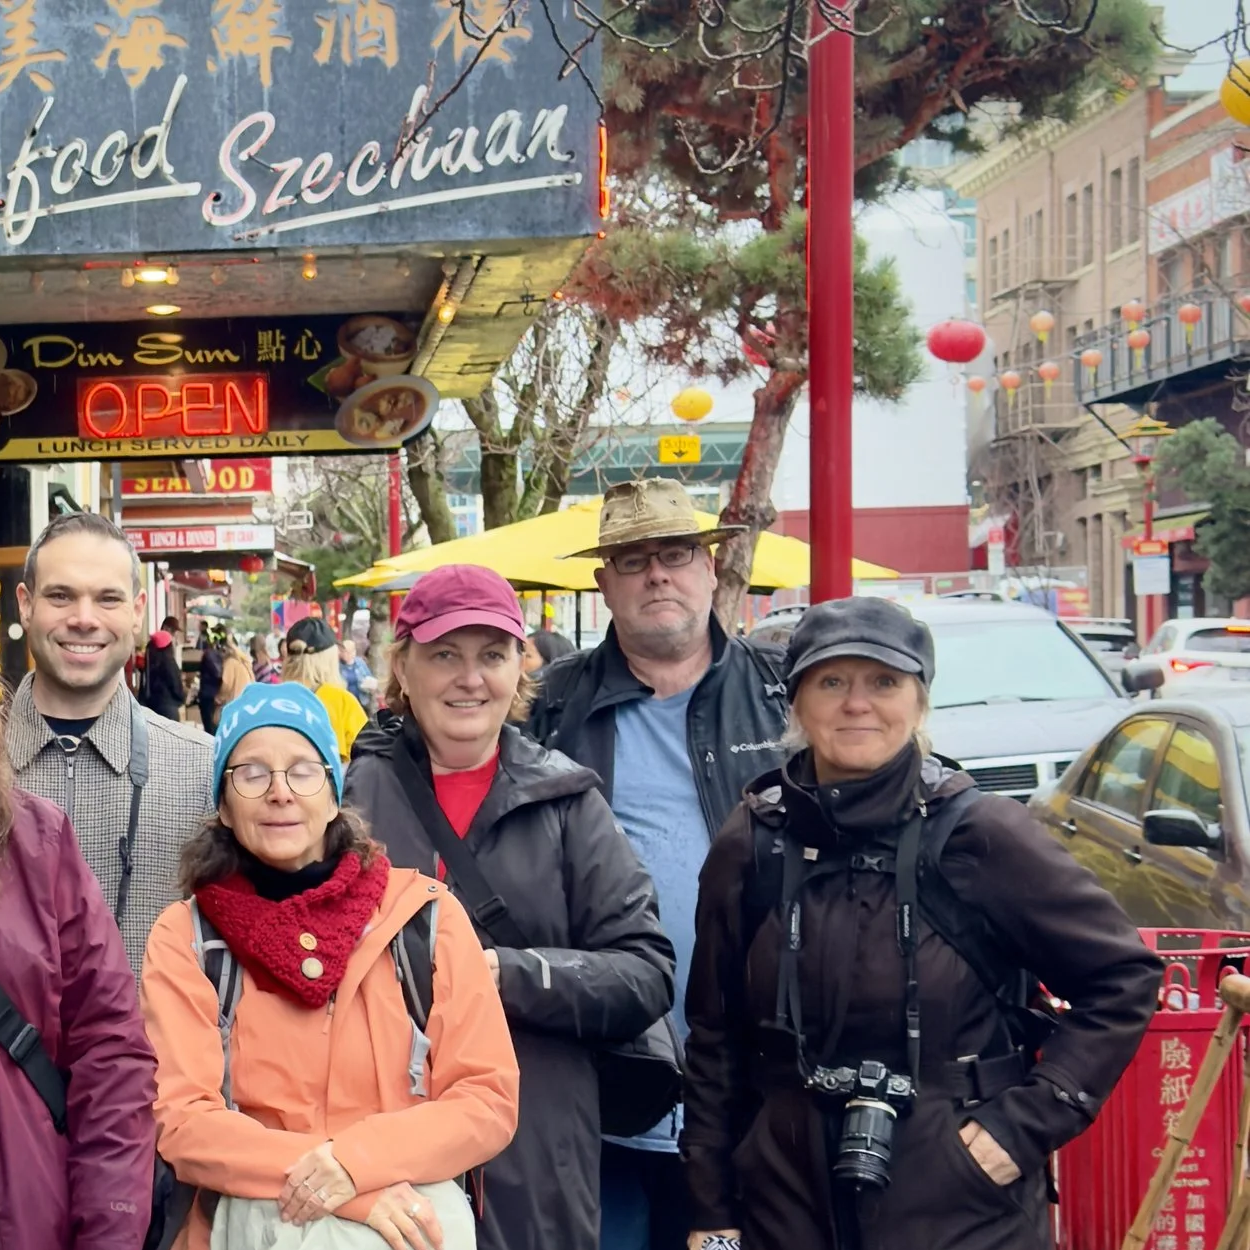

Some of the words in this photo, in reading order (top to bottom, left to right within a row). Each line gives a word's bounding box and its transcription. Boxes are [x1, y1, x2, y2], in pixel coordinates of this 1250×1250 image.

[202, 85, 577, 226] Szechuan
[23, 335, 123, 368] Dim
[134, 333, 240, 366] Sum
[257, 328, 322, 362] 點心
[84, 378, 264, 438] OPEN
[37, 440, 123, 454] LUNCH
[131, 436, 230, 452] SERVED
[240, 434, 310, 448] DAILY
